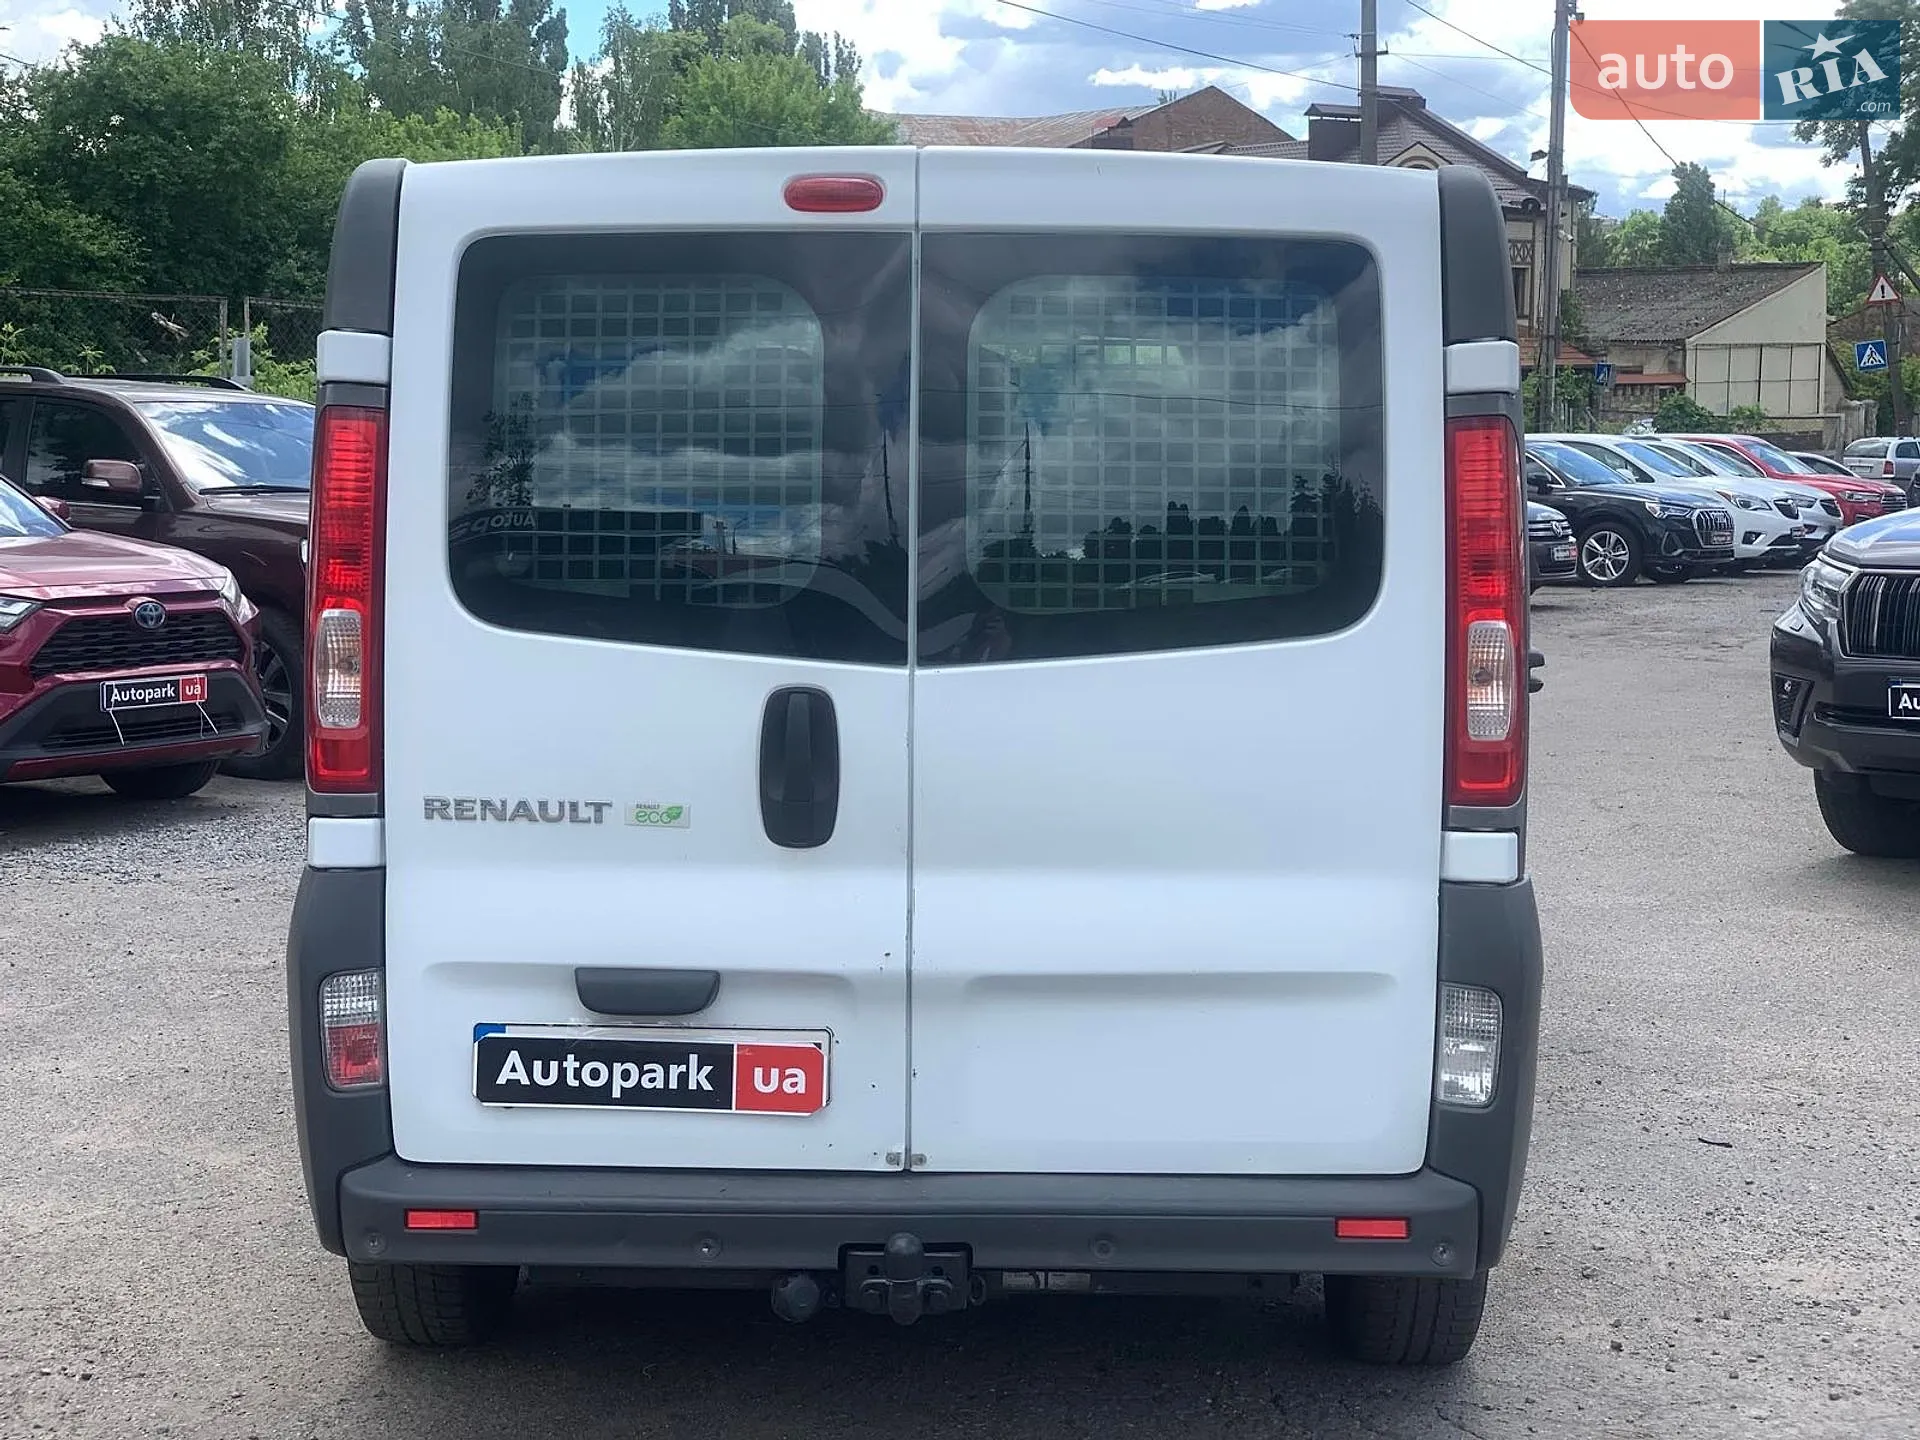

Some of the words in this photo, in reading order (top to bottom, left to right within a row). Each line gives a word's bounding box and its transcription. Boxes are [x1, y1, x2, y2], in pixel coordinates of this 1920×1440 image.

[111, 683, 176, 703] Autopark
[185, 683, 201, 696] ua
[423, 796, 613, 825] RENAULT
[495, 1050, 714, 1099] Autopark
[752, 1064, 808, 1095] ua
